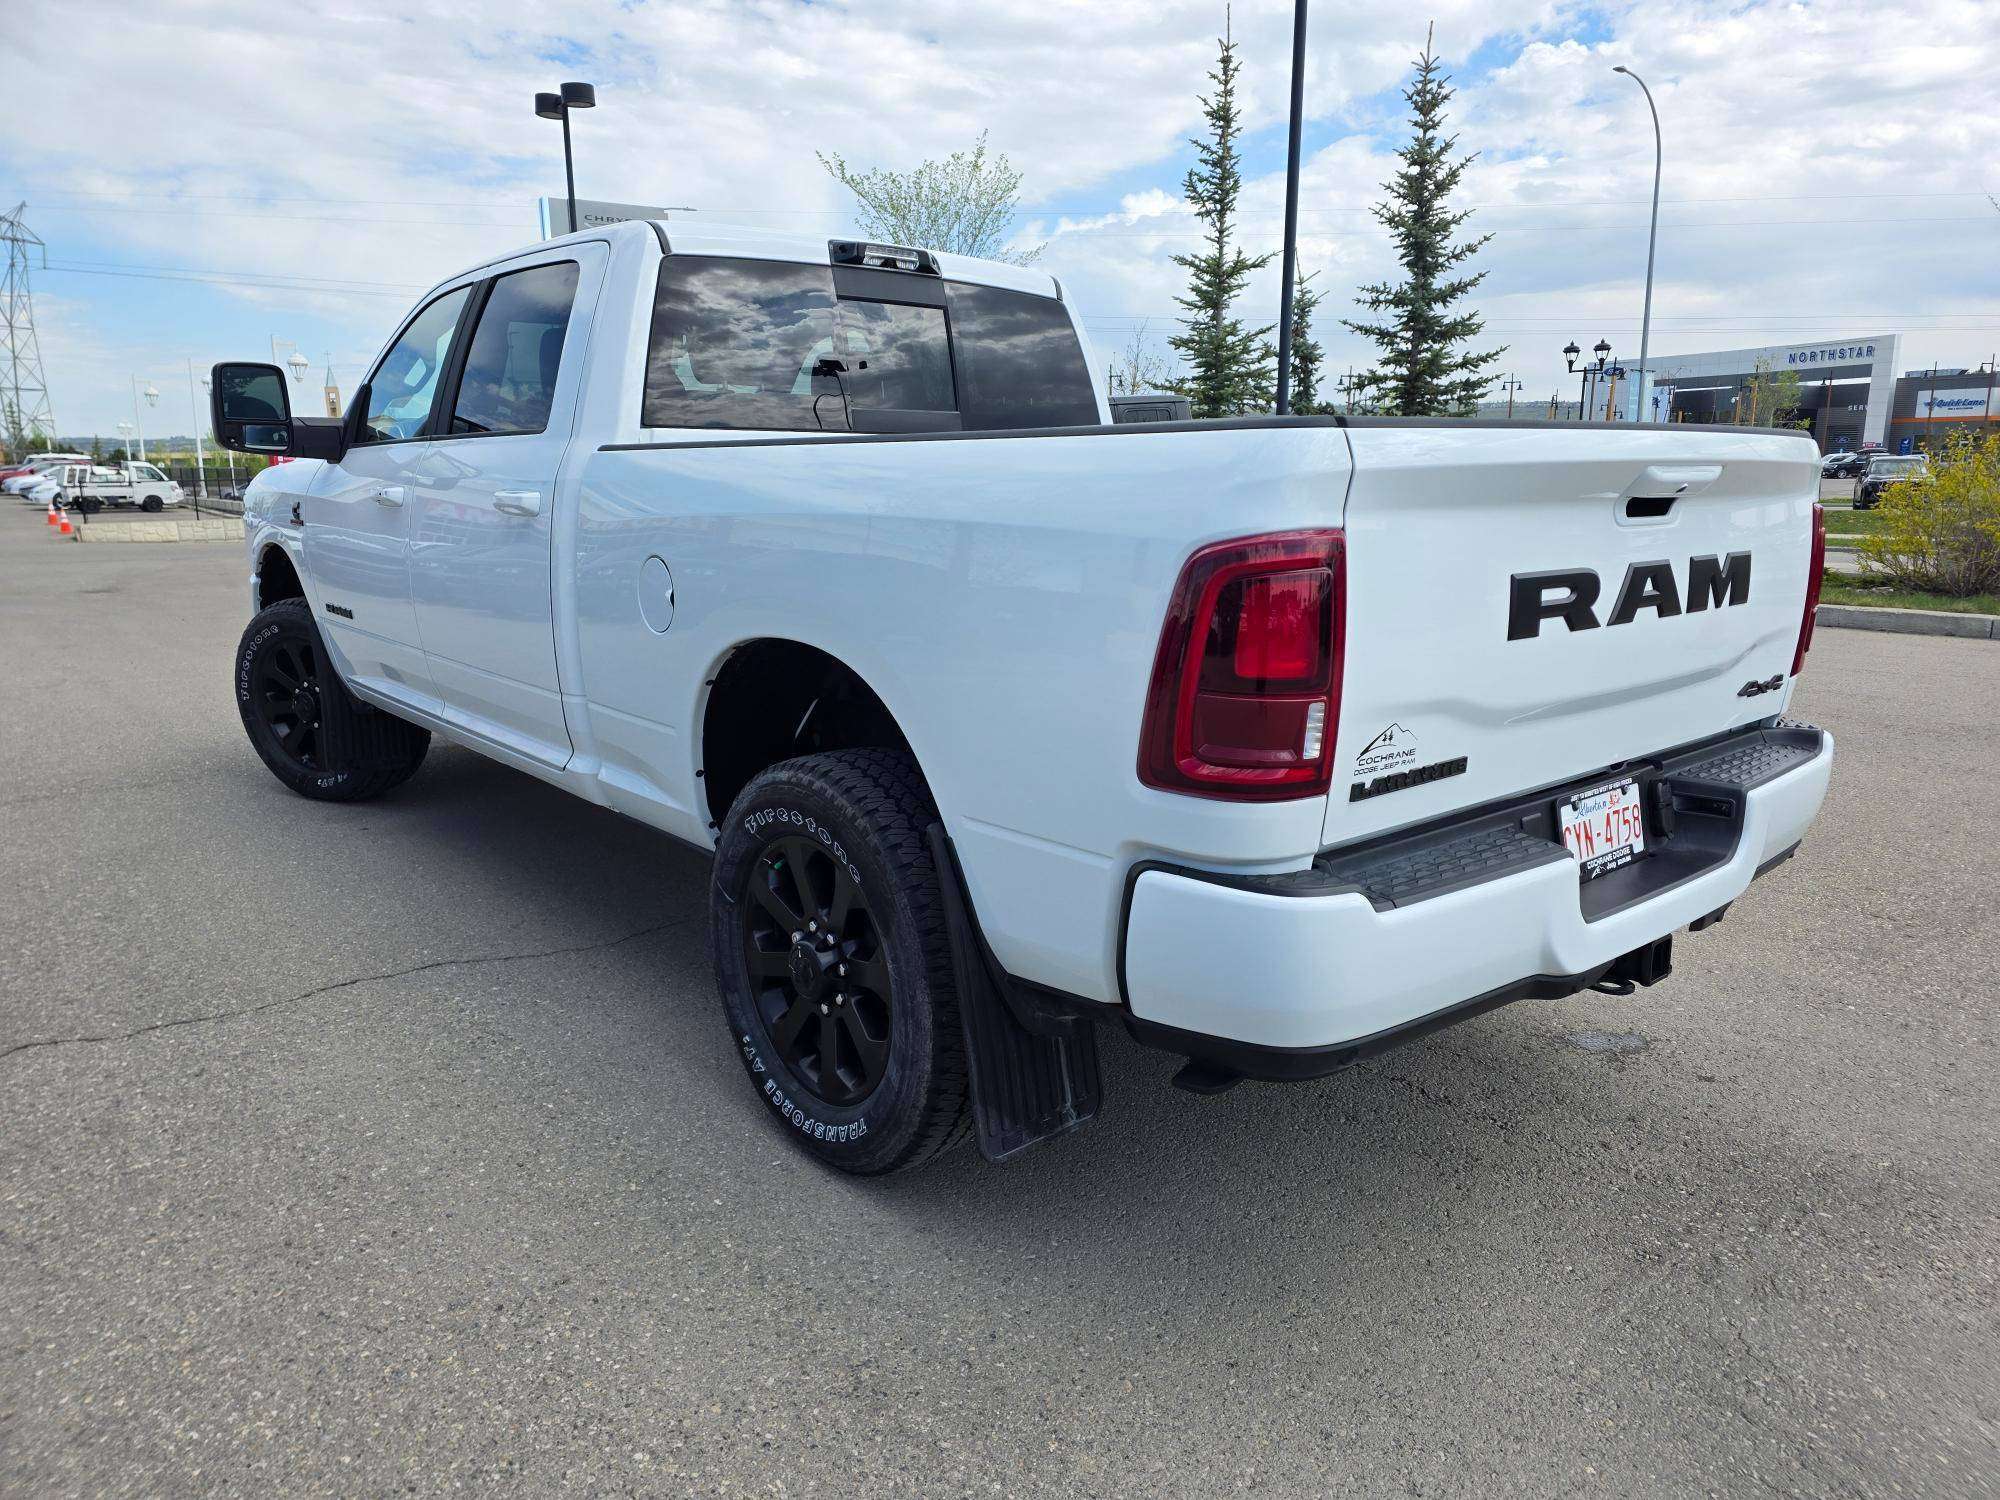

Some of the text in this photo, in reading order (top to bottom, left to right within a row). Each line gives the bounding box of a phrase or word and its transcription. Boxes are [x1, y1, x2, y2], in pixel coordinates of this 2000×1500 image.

[1788, 345, 1875, 364] NORTHSTAR
[1507, 550, 1752, 641] RAM
[1353, 757, 1416, 777] DODGE JEEP RAM
[1358, 748, 1416, 767] COCHRANE
[763, 1079, 867, 1142] TRANSFORCE
